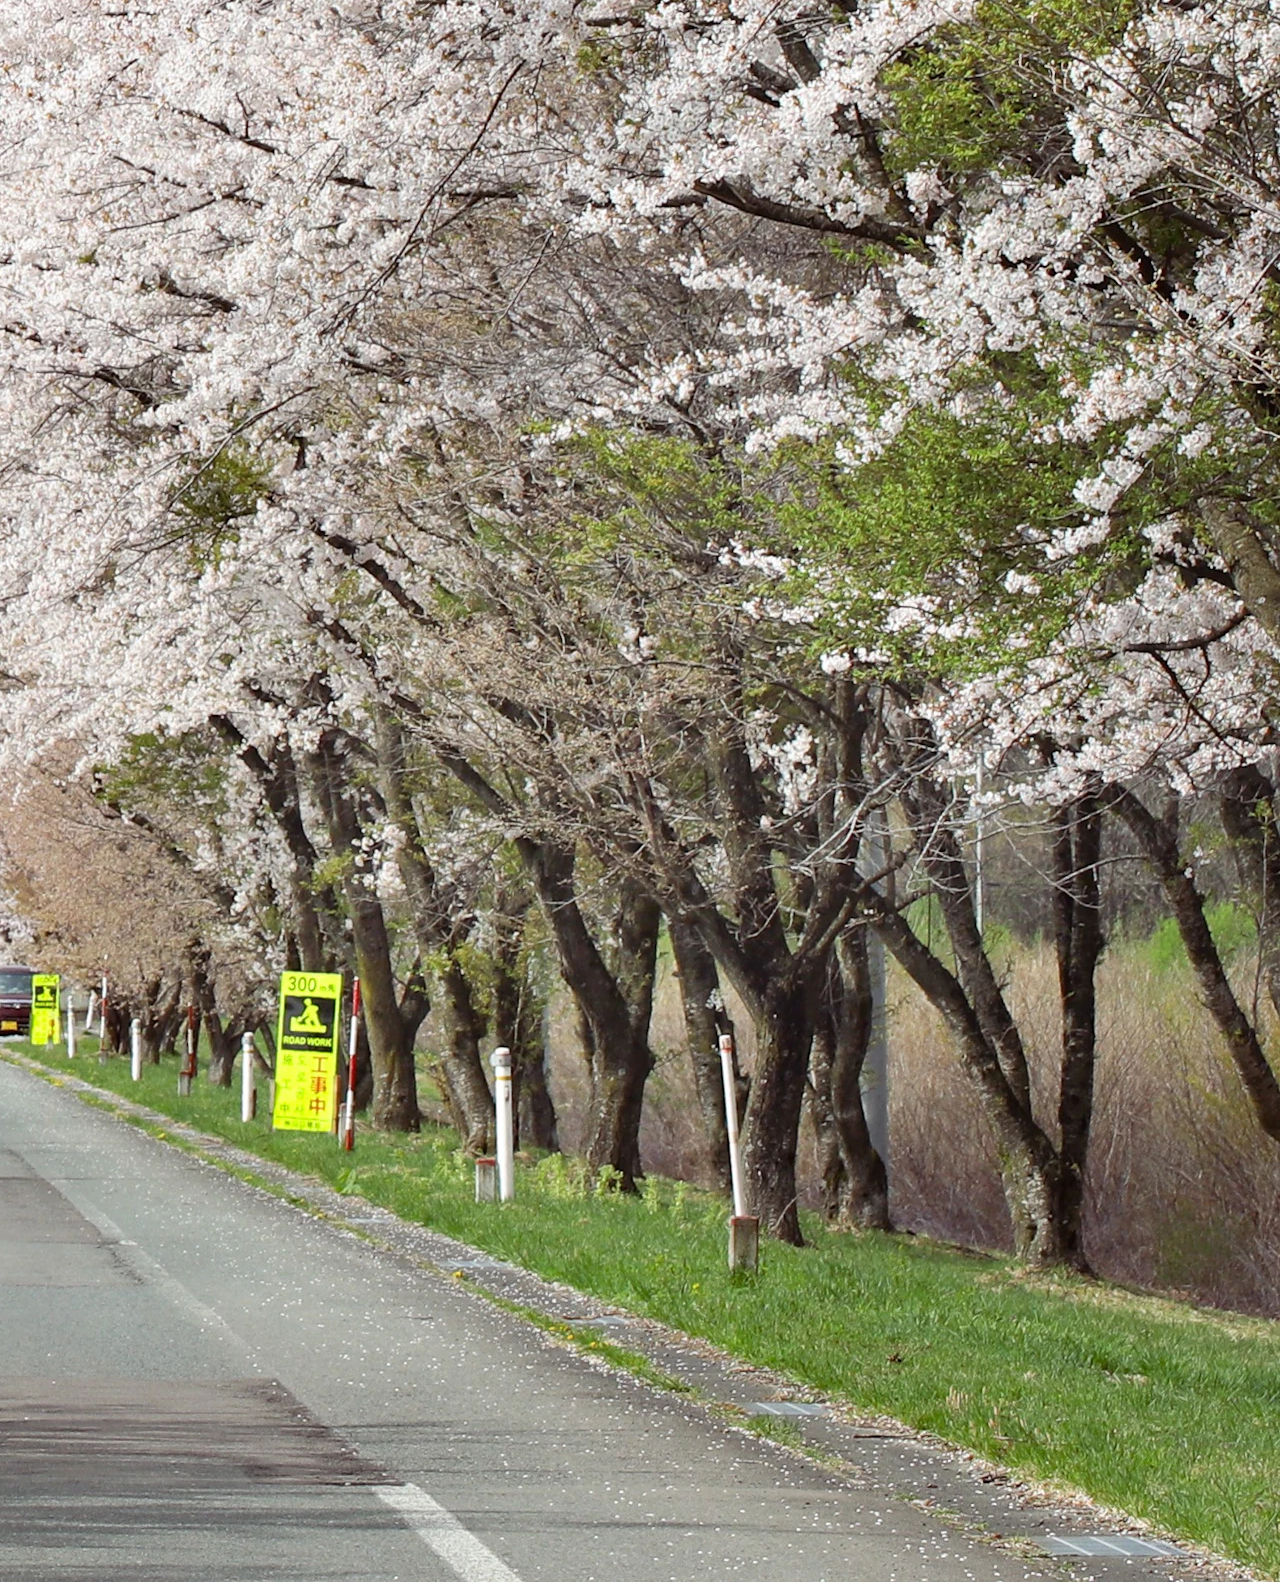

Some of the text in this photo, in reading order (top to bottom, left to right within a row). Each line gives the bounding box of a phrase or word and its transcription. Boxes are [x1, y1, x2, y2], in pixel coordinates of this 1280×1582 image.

[283, 1035, 332, 1047] ROAD WORK
[309, 1056, 328, 1116] 工事中
